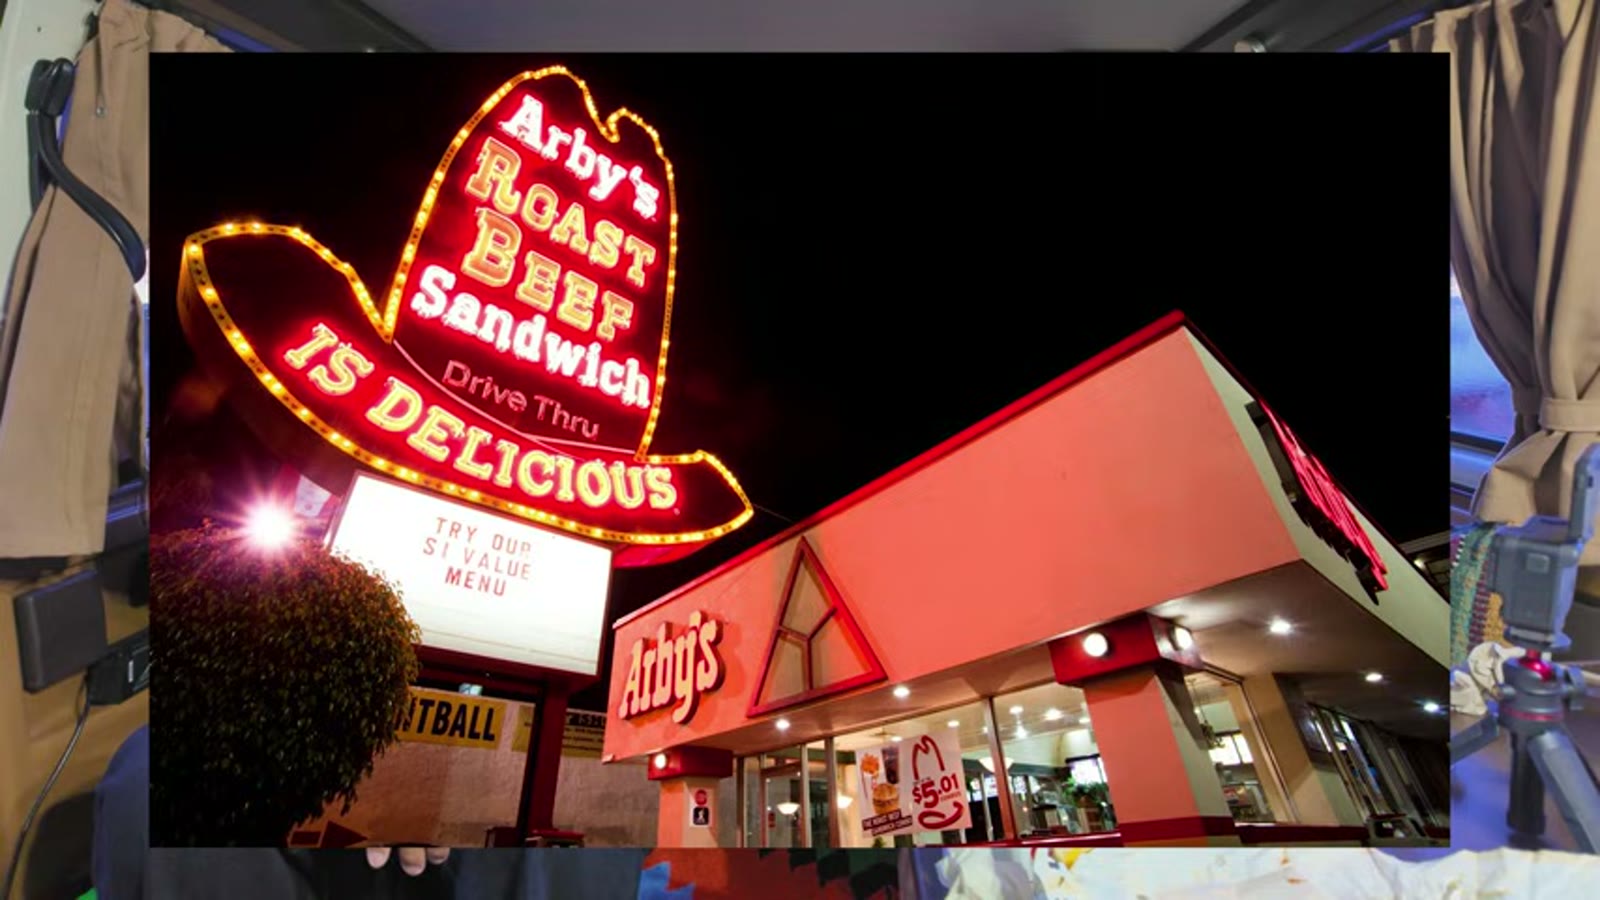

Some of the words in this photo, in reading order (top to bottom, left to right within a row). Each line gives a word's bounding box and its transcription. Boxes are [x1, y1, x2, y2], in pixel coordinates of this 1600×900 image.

[464, 135, 657, 287] ROAST
[498, 94, 660, 219] Arby's
[460, 206, 634, 341] BEEF
[410, 264, 651, 409] Sandwich
[284, 322, 375, 396] IS
[365, 375, 678, 510] DELICIOUS
[441, 359, 528, 412] Drive
[533, 394, 600, 441] Thru
[436, 516, 478, 543] TRY
[491, 533, 531, 558] OUR
[444, 565, 506, 597] MENU
[463, 546, 531, 581] VALUE
[618, 610, 723, 724] Arby's
[911, 772, 960, 809] $5.01
